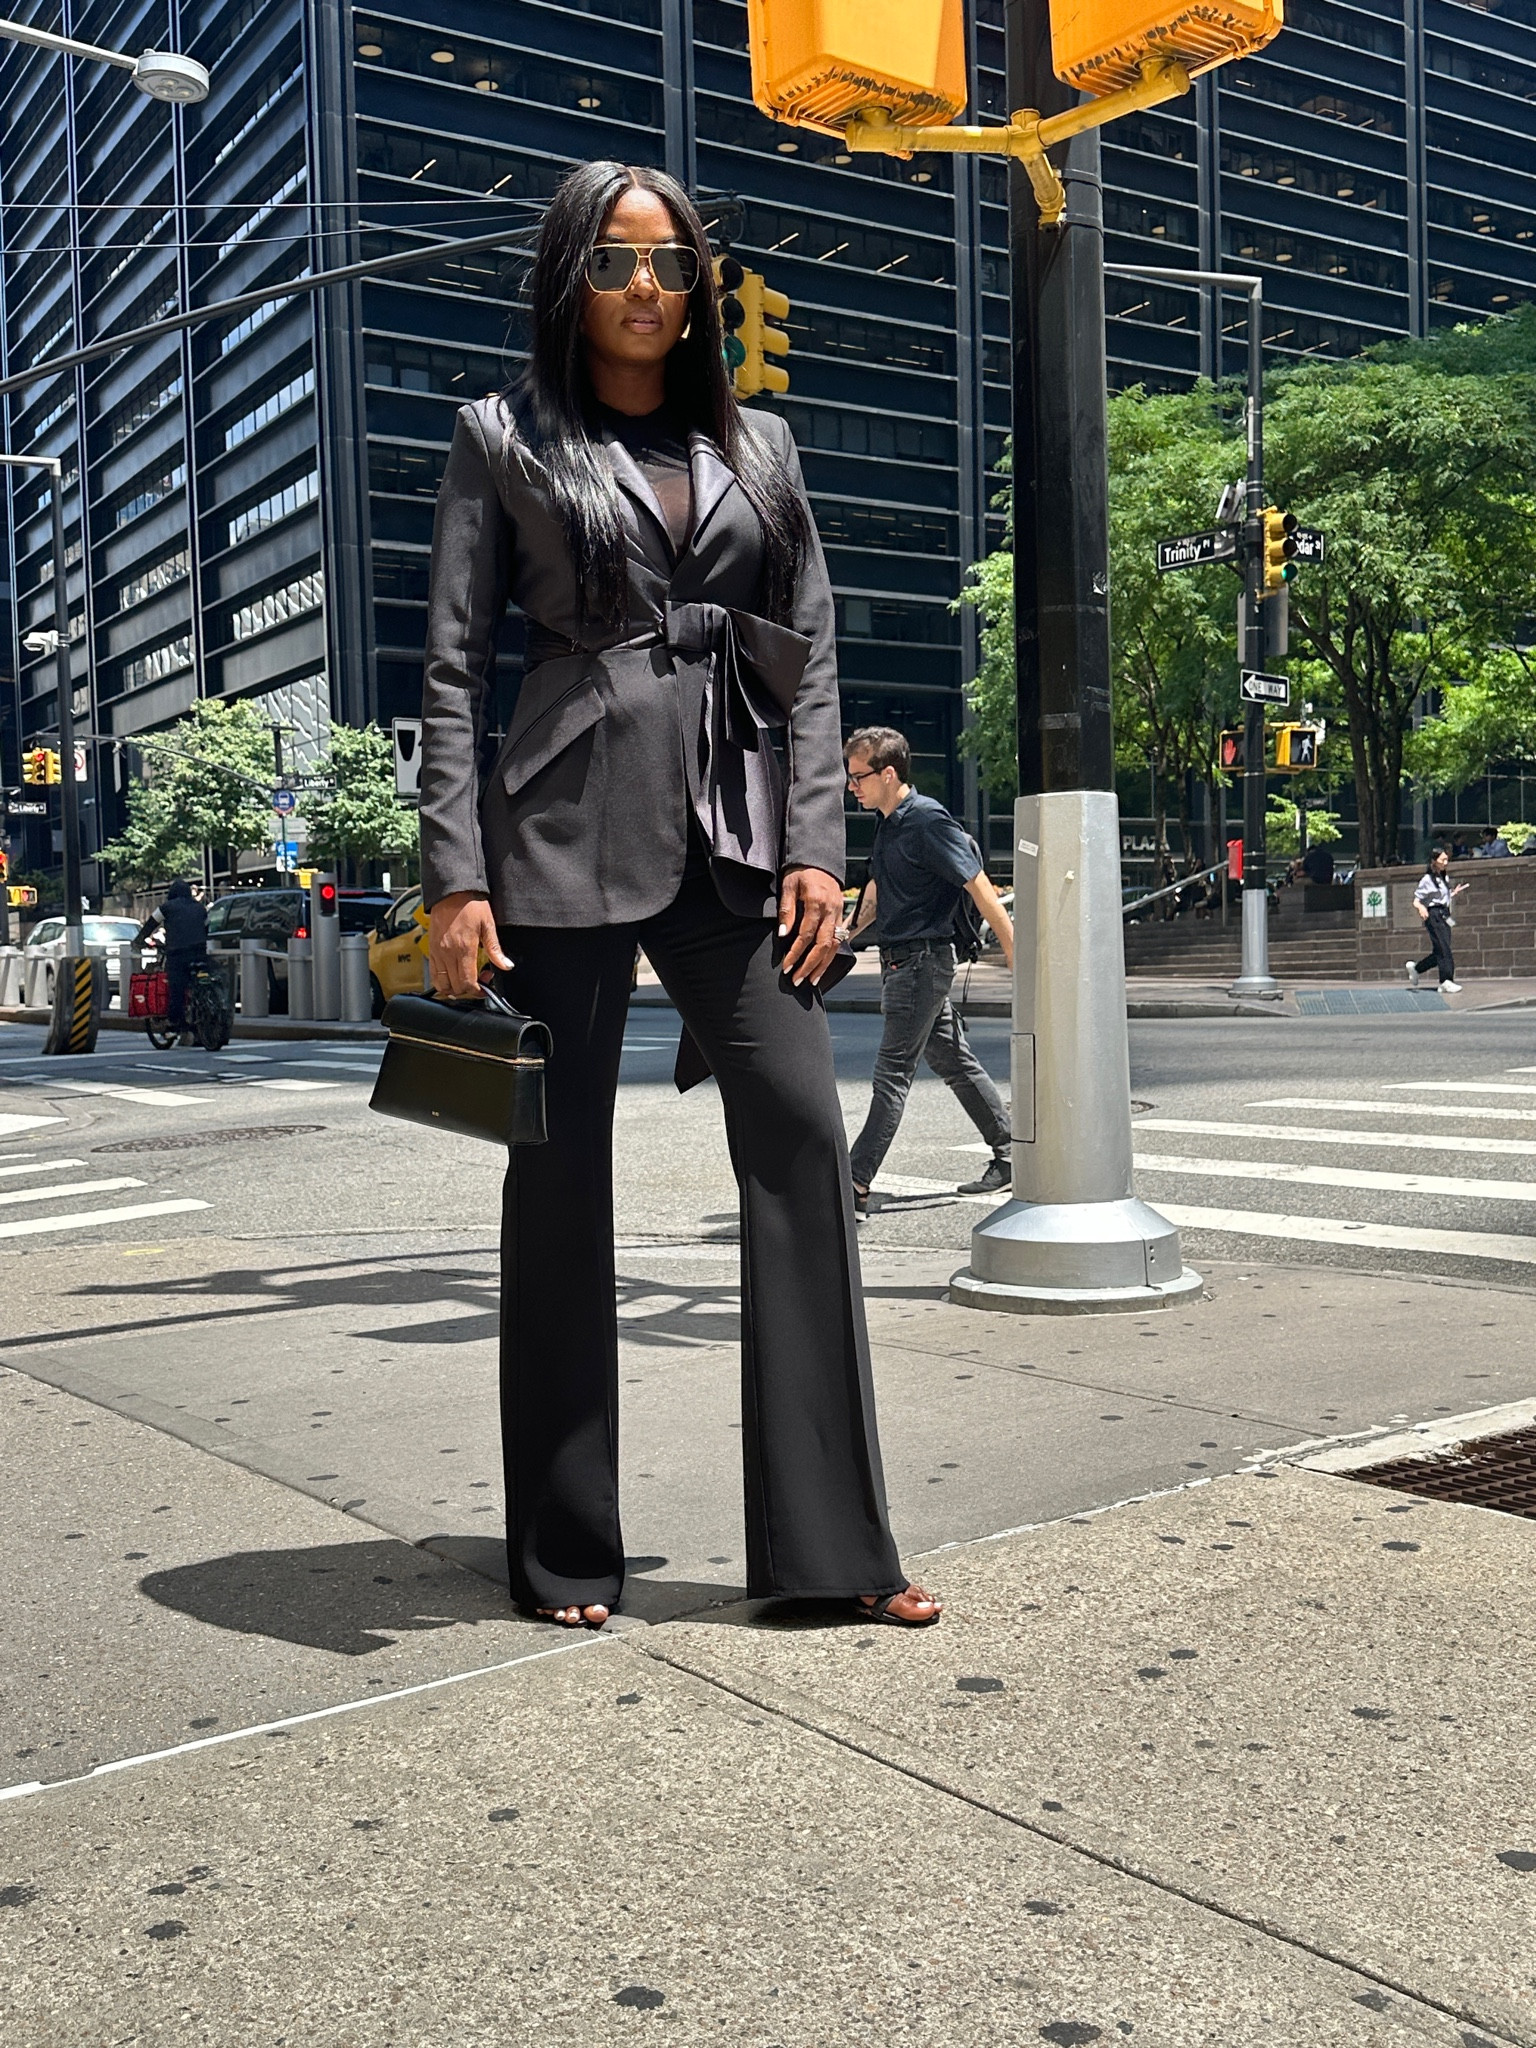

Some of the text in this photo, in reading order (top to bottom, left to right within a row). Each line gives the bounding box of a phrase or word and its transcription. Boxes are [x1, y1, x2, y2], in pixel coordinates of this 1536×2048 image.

[1164, 543, 1201, 563] Trinity
[1248, 681, 1282, 694] ONE WAY
[304, 779, 329, 788] Liberty
